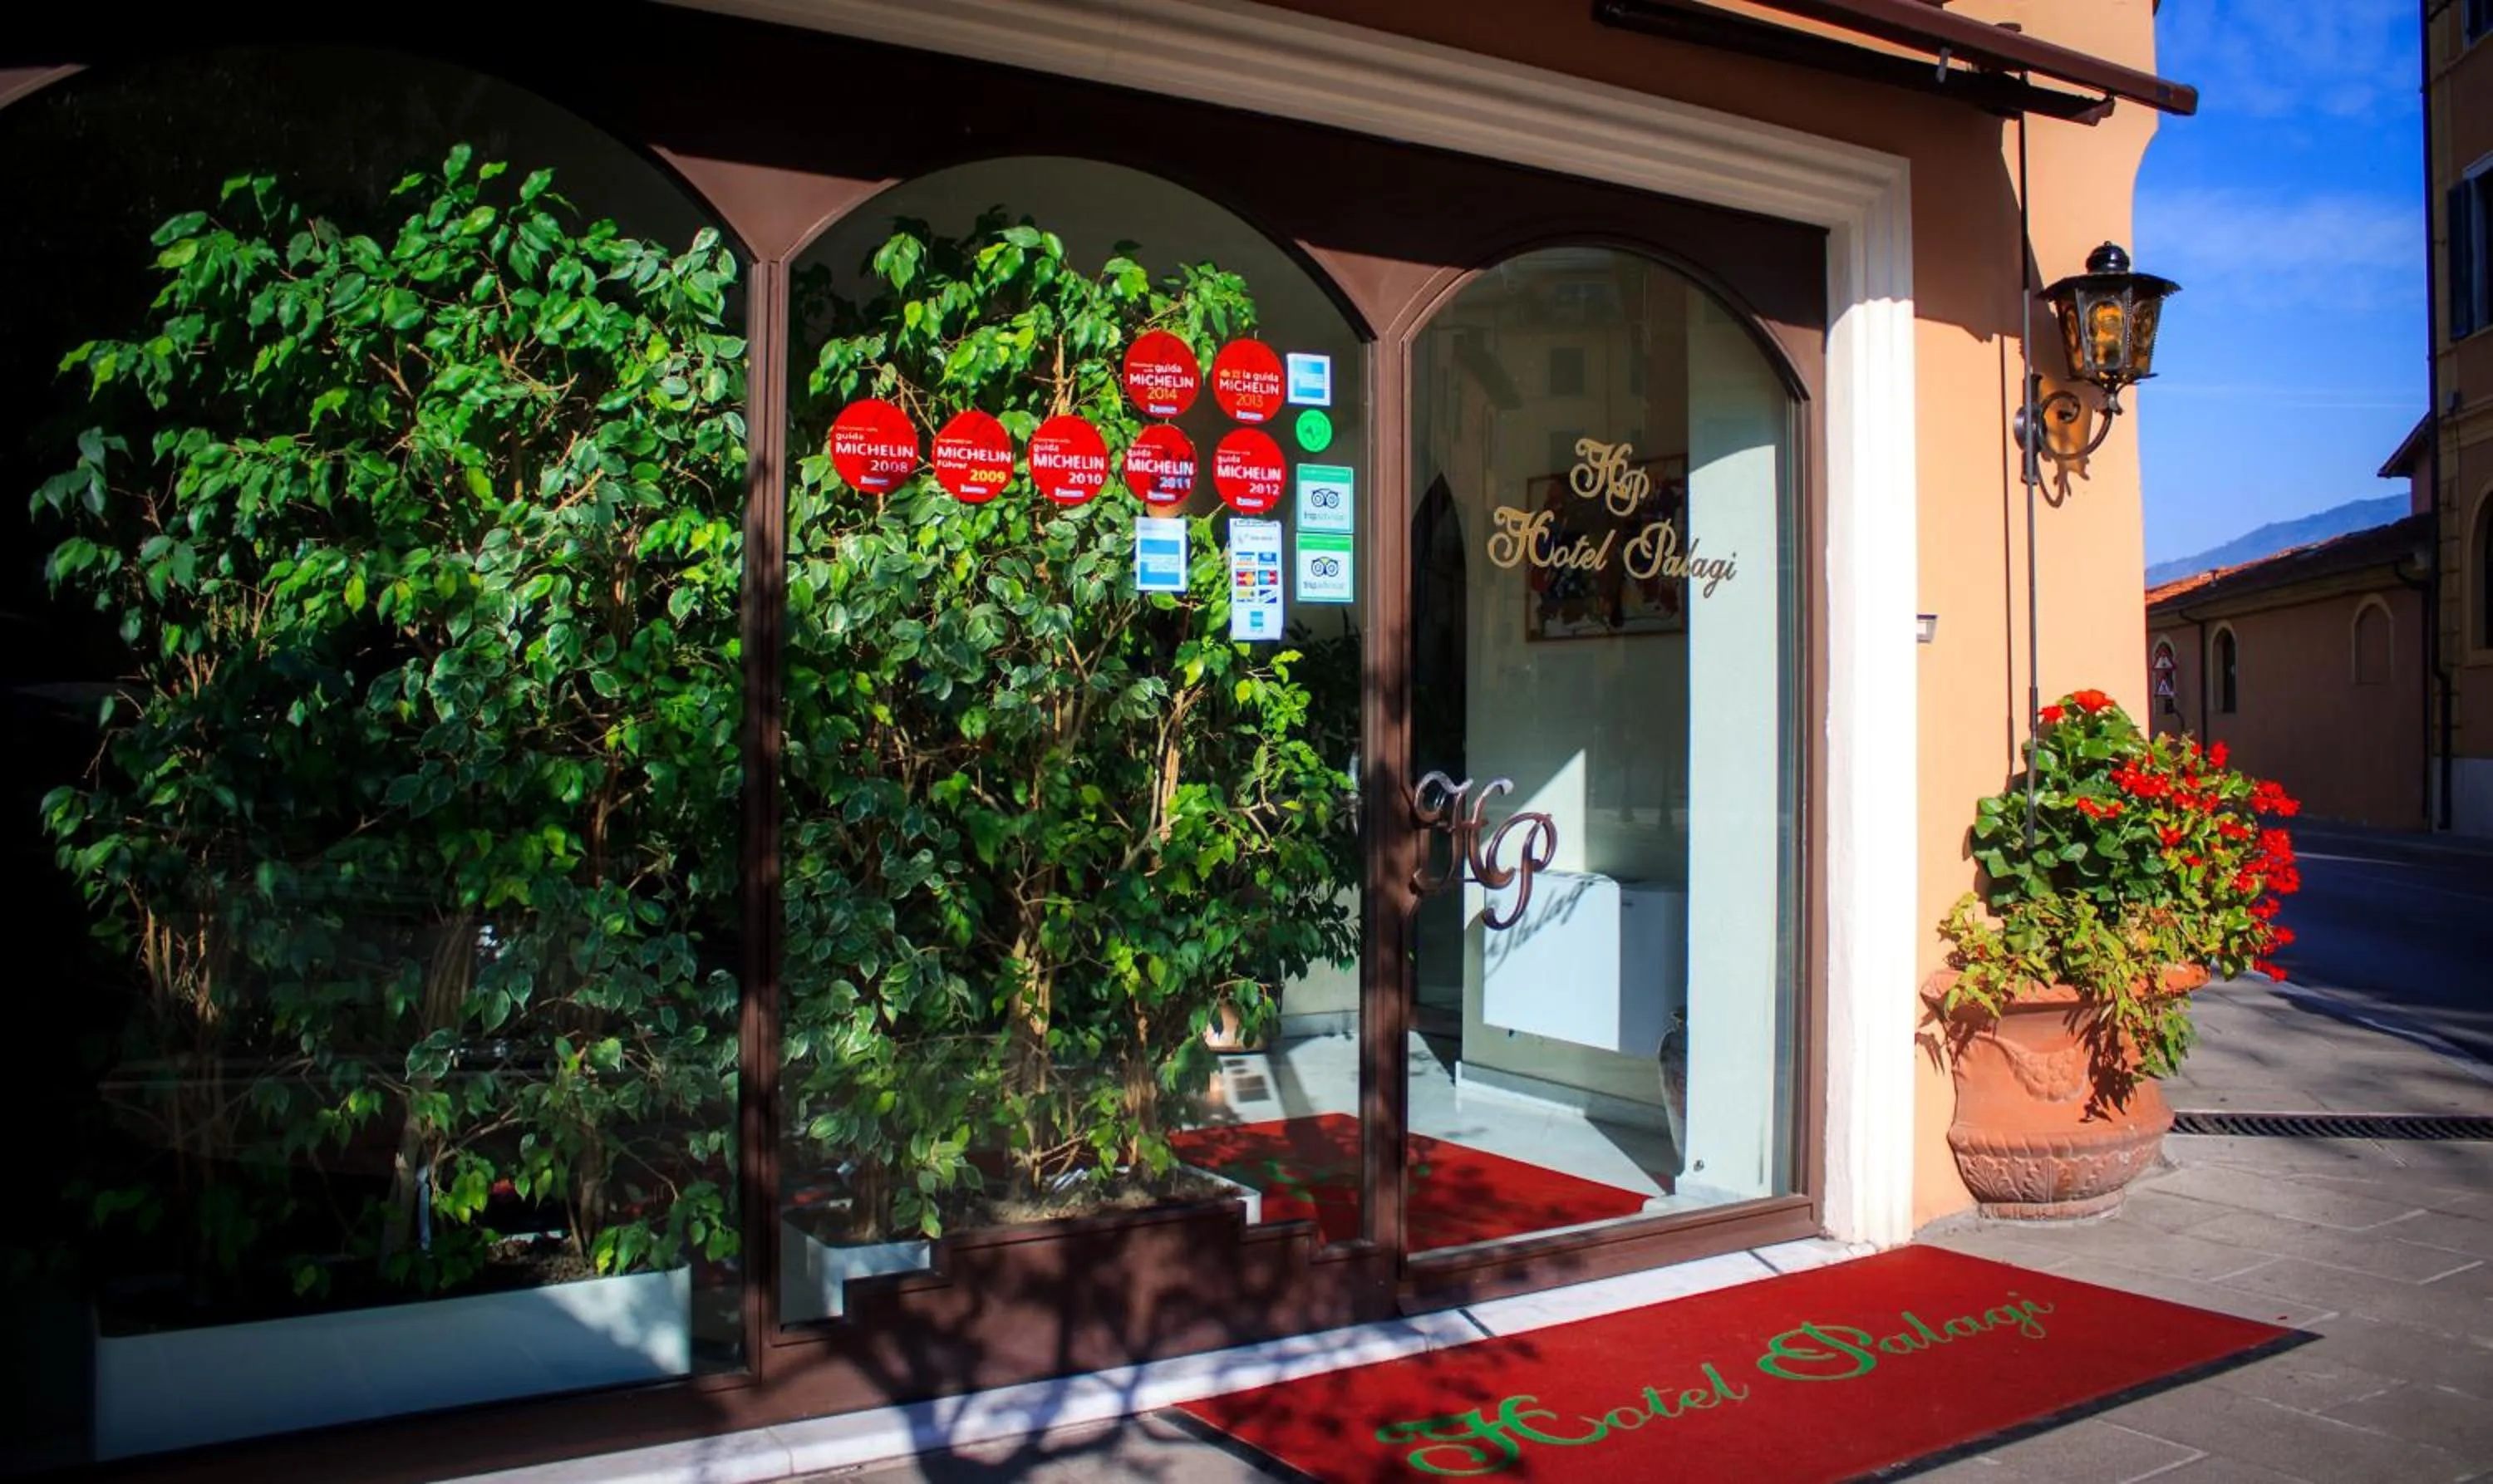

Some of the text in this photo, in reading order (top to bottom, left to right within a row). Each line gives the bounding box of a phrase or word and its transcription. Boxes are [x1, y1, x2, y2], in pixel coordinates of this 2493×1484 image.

[1129, 373, 1194, 389] MICHELIN
[1252, 371, 1279, 382] guida
[1147, 386, 1178, 400] 2014
[1219, 379, 1280, 396] MICHELIN
[1236, 393, 1264, 408] 2013
[835, 441, 914, 458] MICHELIN
[937, 445, 1011, 464] MICHELIN
[870, 459, 909, 474] 2008
[1033, 453, 1104, 471] MICHELIN
[1128, 458, 1193, 476] MICHELIN
[969, 469, 1006, 484] 2009
[1068, 471, 1103, 485] 2010
[1217, 464, 1281, 481] MICHELIN
[1159, 476, 1191, 489] 2011
[1249, 483, 1281, 496] 2012
[1487, 505, 1737, 599] Hotel Palagi
[1375, 1291, 2055, 1476] Hotel Palagi
